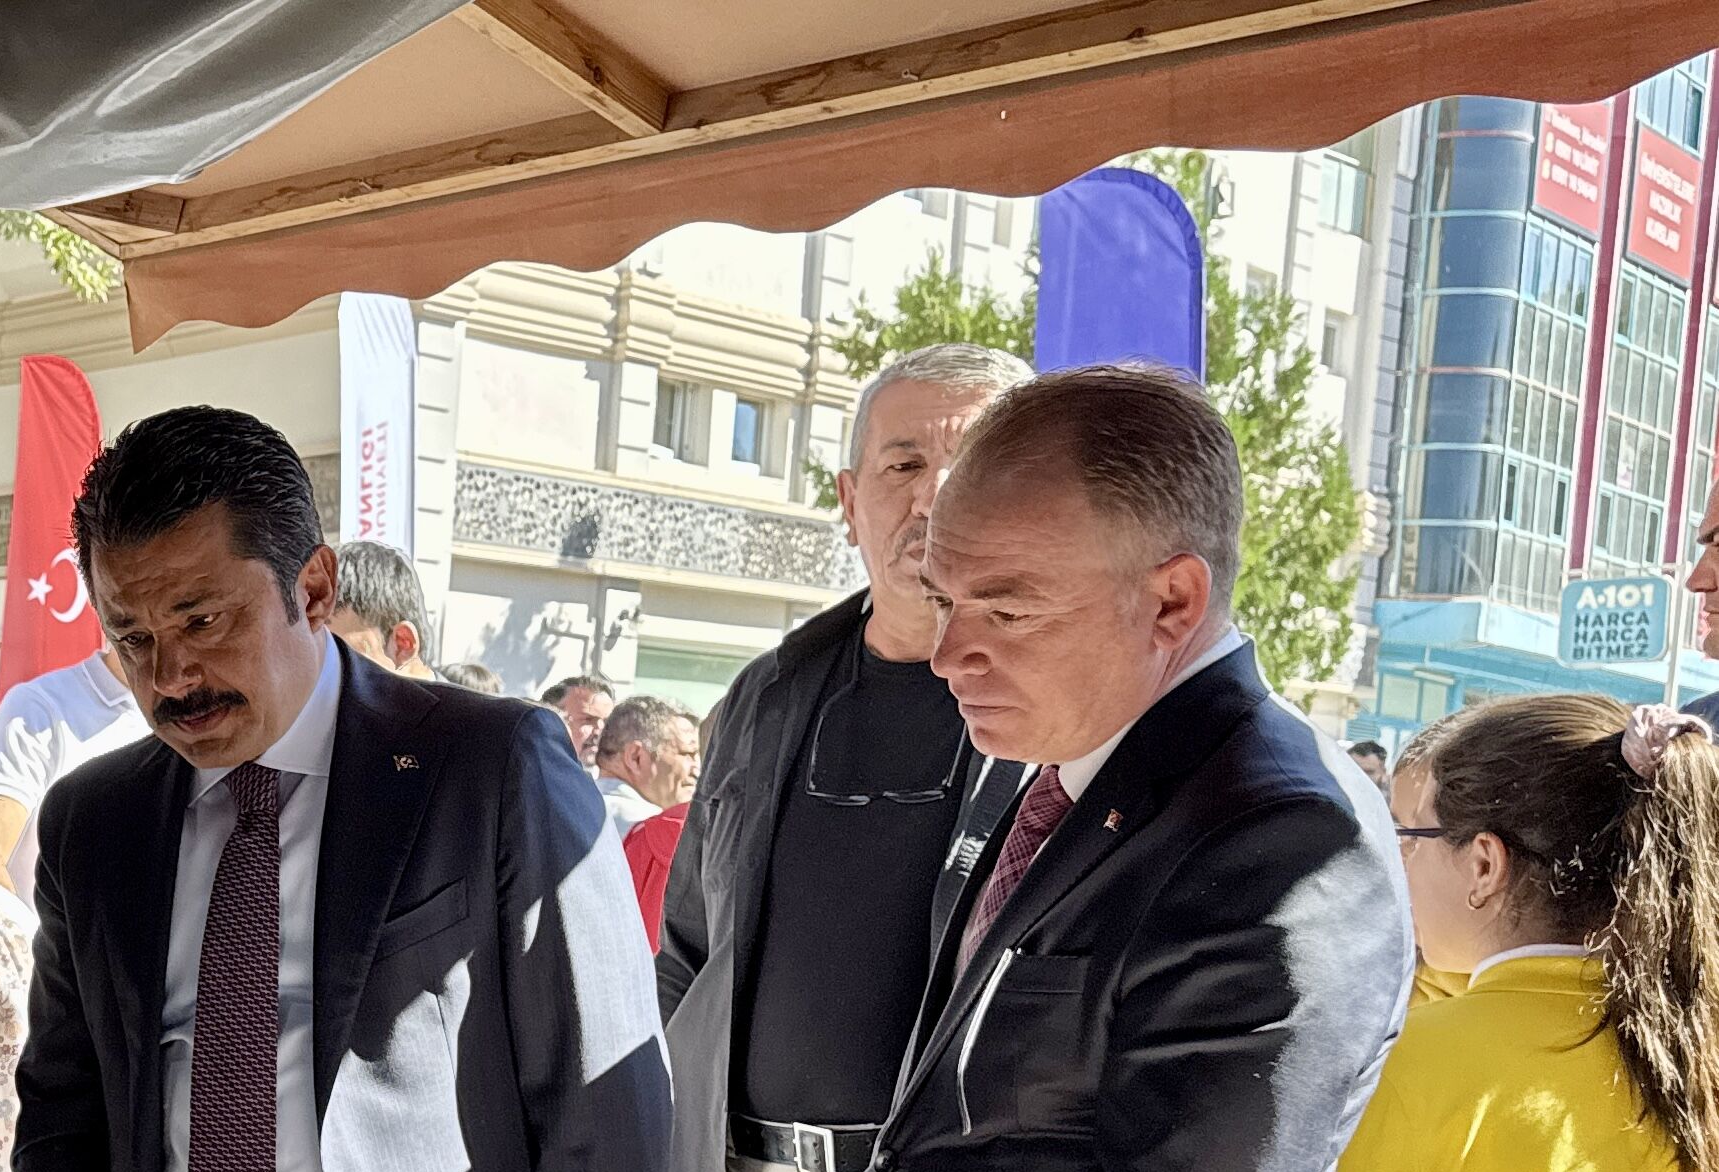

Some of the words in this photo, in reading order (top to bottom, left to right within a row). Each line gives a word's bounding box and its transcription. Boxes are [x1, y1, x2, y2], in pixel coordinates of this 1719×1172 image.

[1574, 610, 1650, 628] HARCA
[1573, 628, 1649, 644] HARCA
[1572, 643, 1650, 660] BİTMEZ
